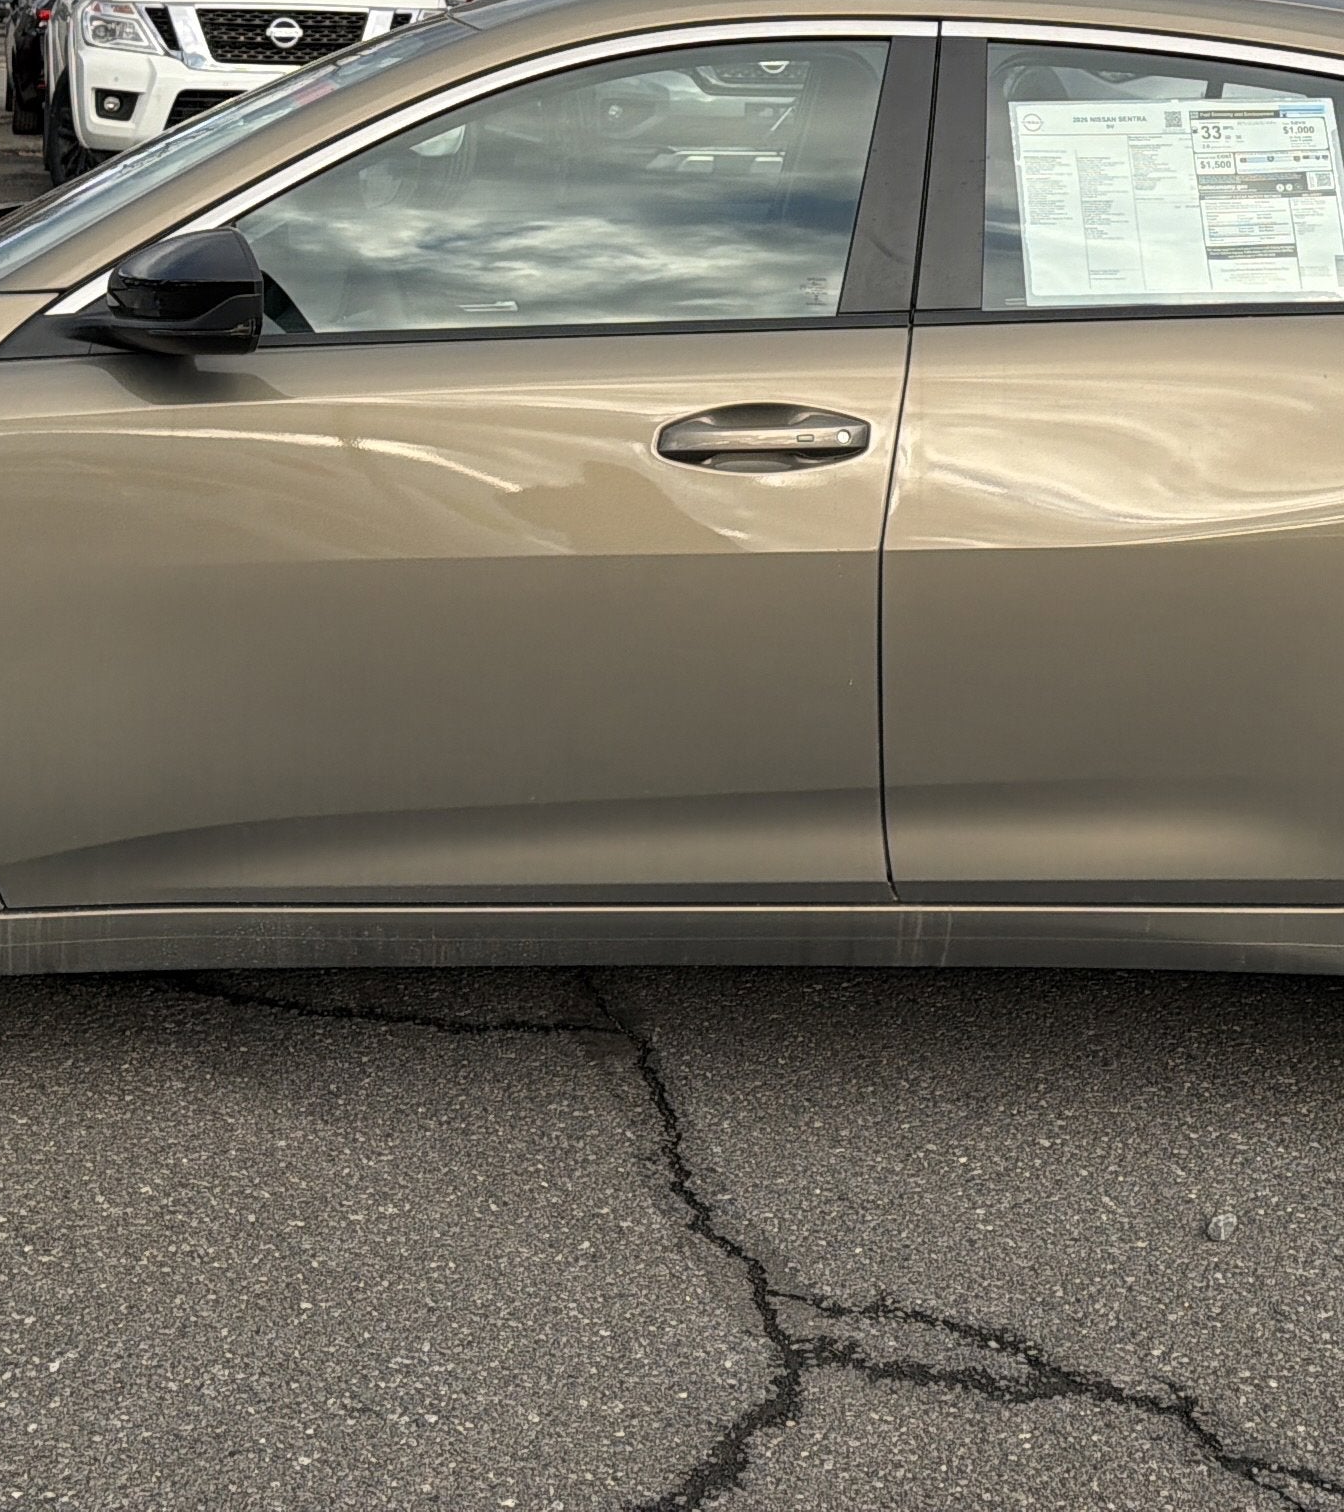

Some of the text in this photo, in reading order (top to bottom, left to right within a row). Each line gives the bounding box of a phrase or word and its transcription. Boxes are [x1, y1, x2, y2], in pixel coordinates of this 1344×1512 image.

[1201, 125, 1222, 140] 33
[1282, 125, 1315, 135] $1,000
[1200, 160, 1232, 170] $1,500
